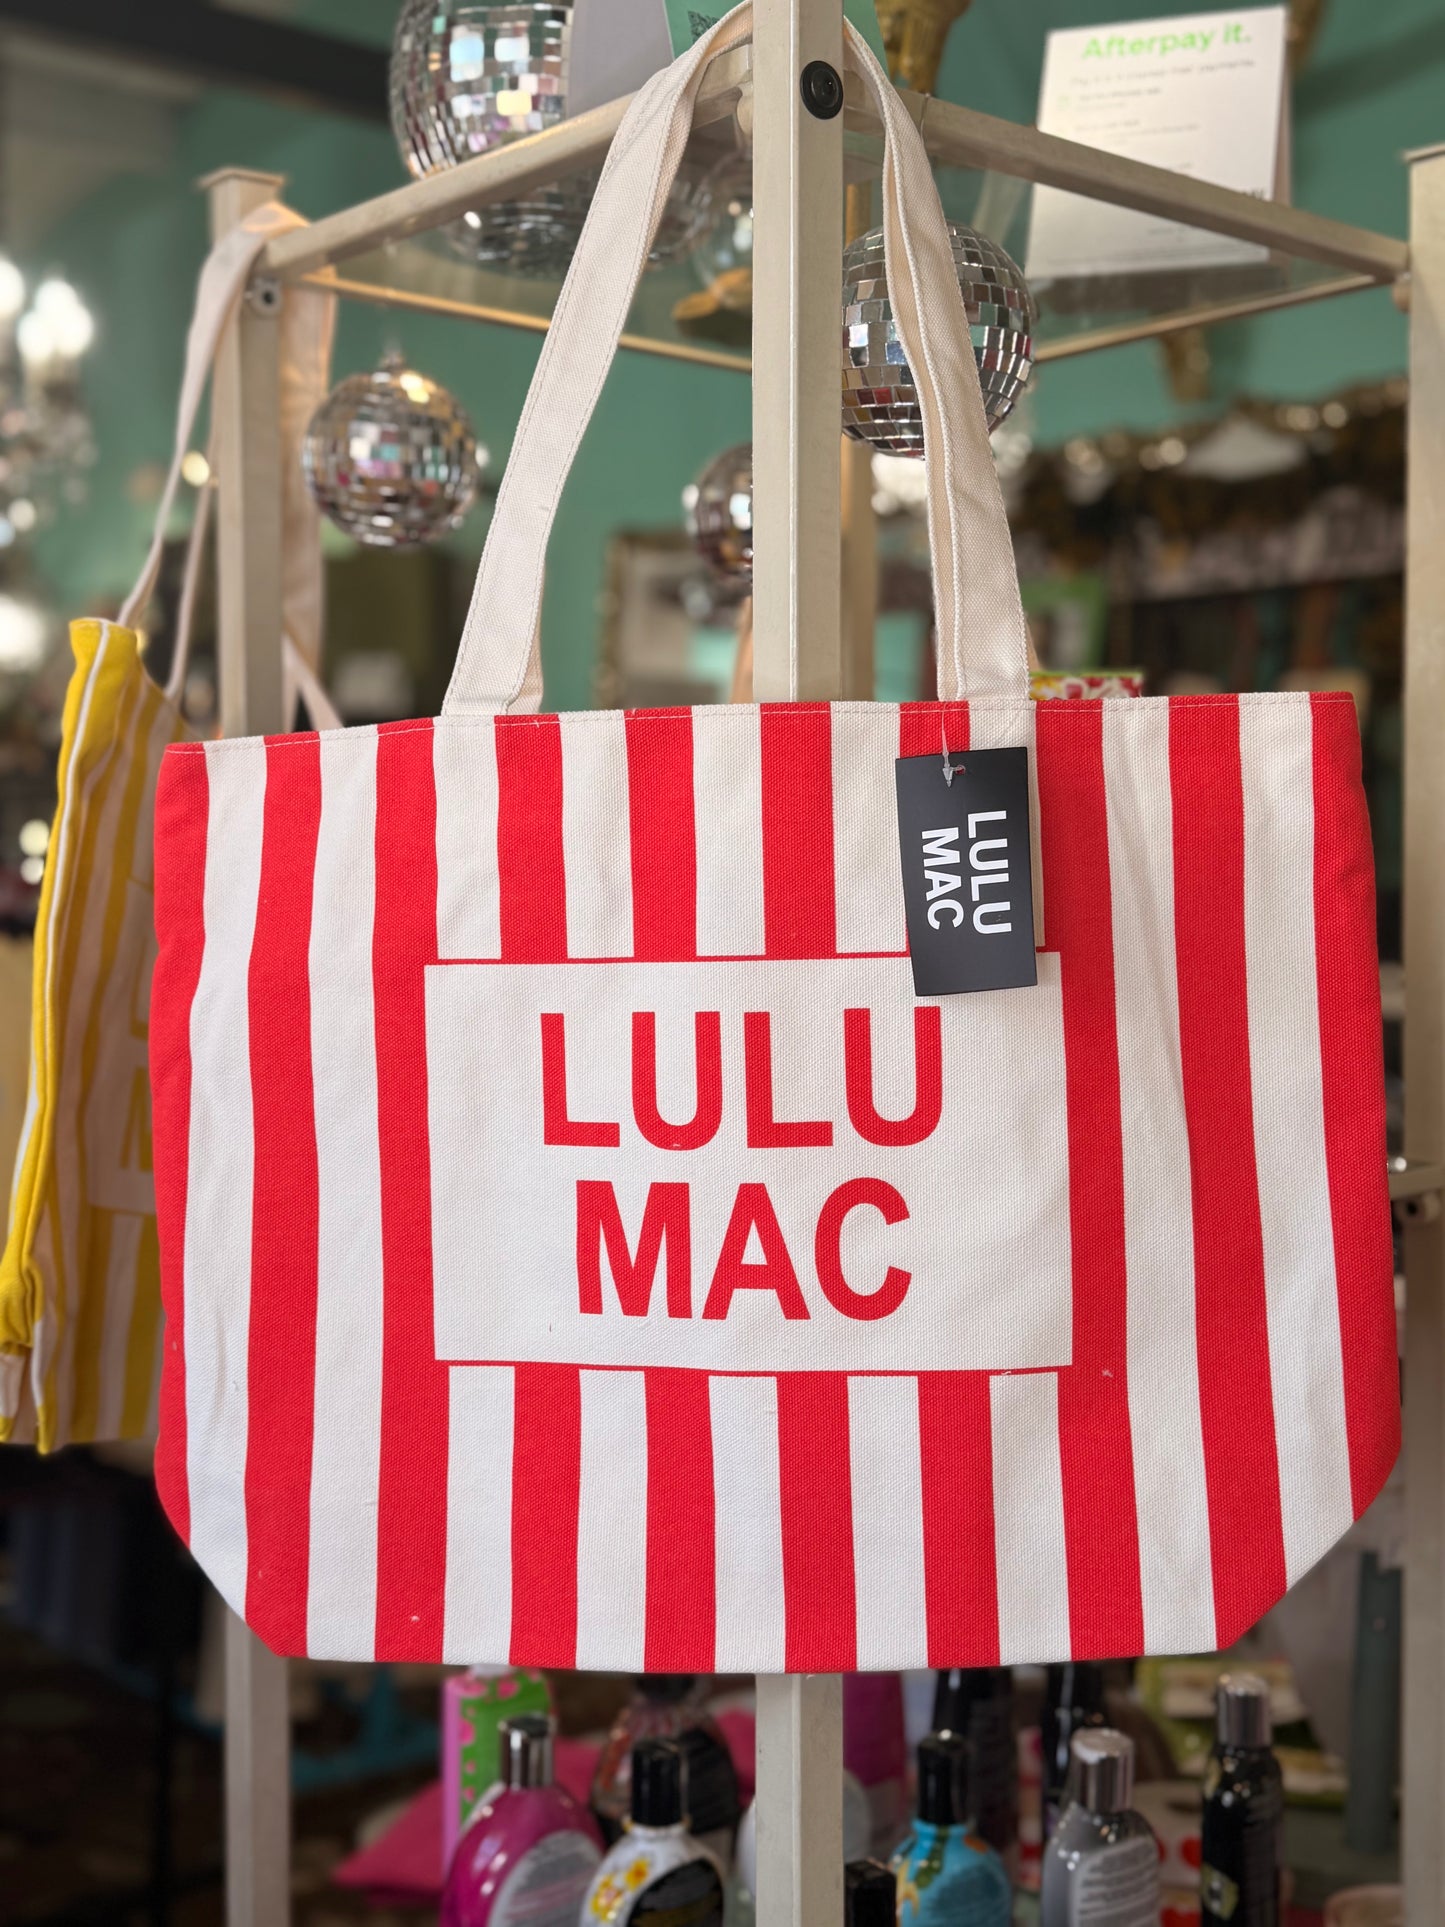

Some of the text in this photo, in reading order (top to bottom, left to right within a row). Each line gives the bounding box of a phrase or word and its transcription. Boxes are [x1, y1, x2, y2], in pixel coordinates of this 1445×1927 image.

[1083, 22, 1252, 58] Afterpay it.
[921, 826, 965, 931] MAC
[968, 810, 1012, 935] LULU
[541, 1006, 943, 1151] LULU
[576, 1177, 912, 1321] MAC
